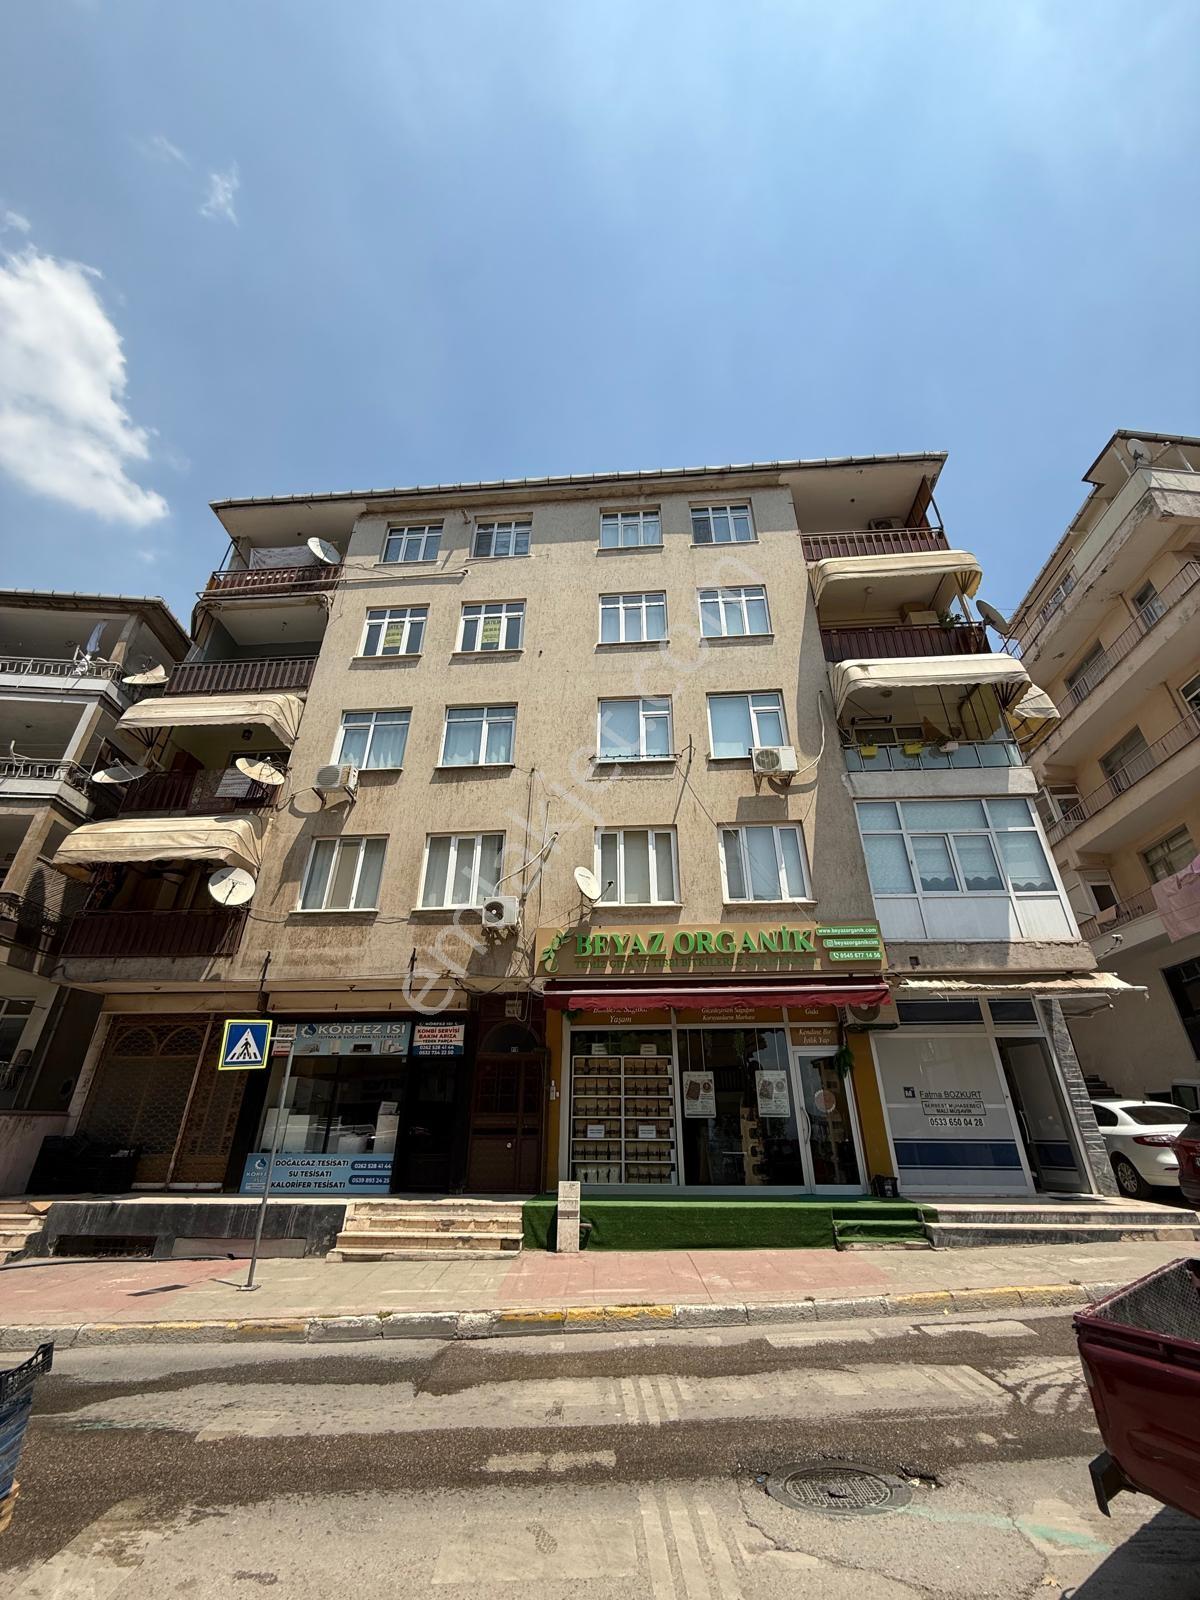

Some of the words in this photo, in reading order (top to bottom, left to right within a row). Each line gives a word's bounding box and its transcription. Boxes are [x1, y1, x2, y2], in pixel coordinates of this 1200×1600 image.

[574, 931, 668, 956] BEYAZ
[673, 924, 817, 955] ORGANİK
[610, 1015, 632, 1024] Yaşam
[318, 1023, 382, 1034] KÖRFEZ
[386, 1024, 406, 1034] ISI
[275, 1158, 316, 1166] DOĞALGAZ
